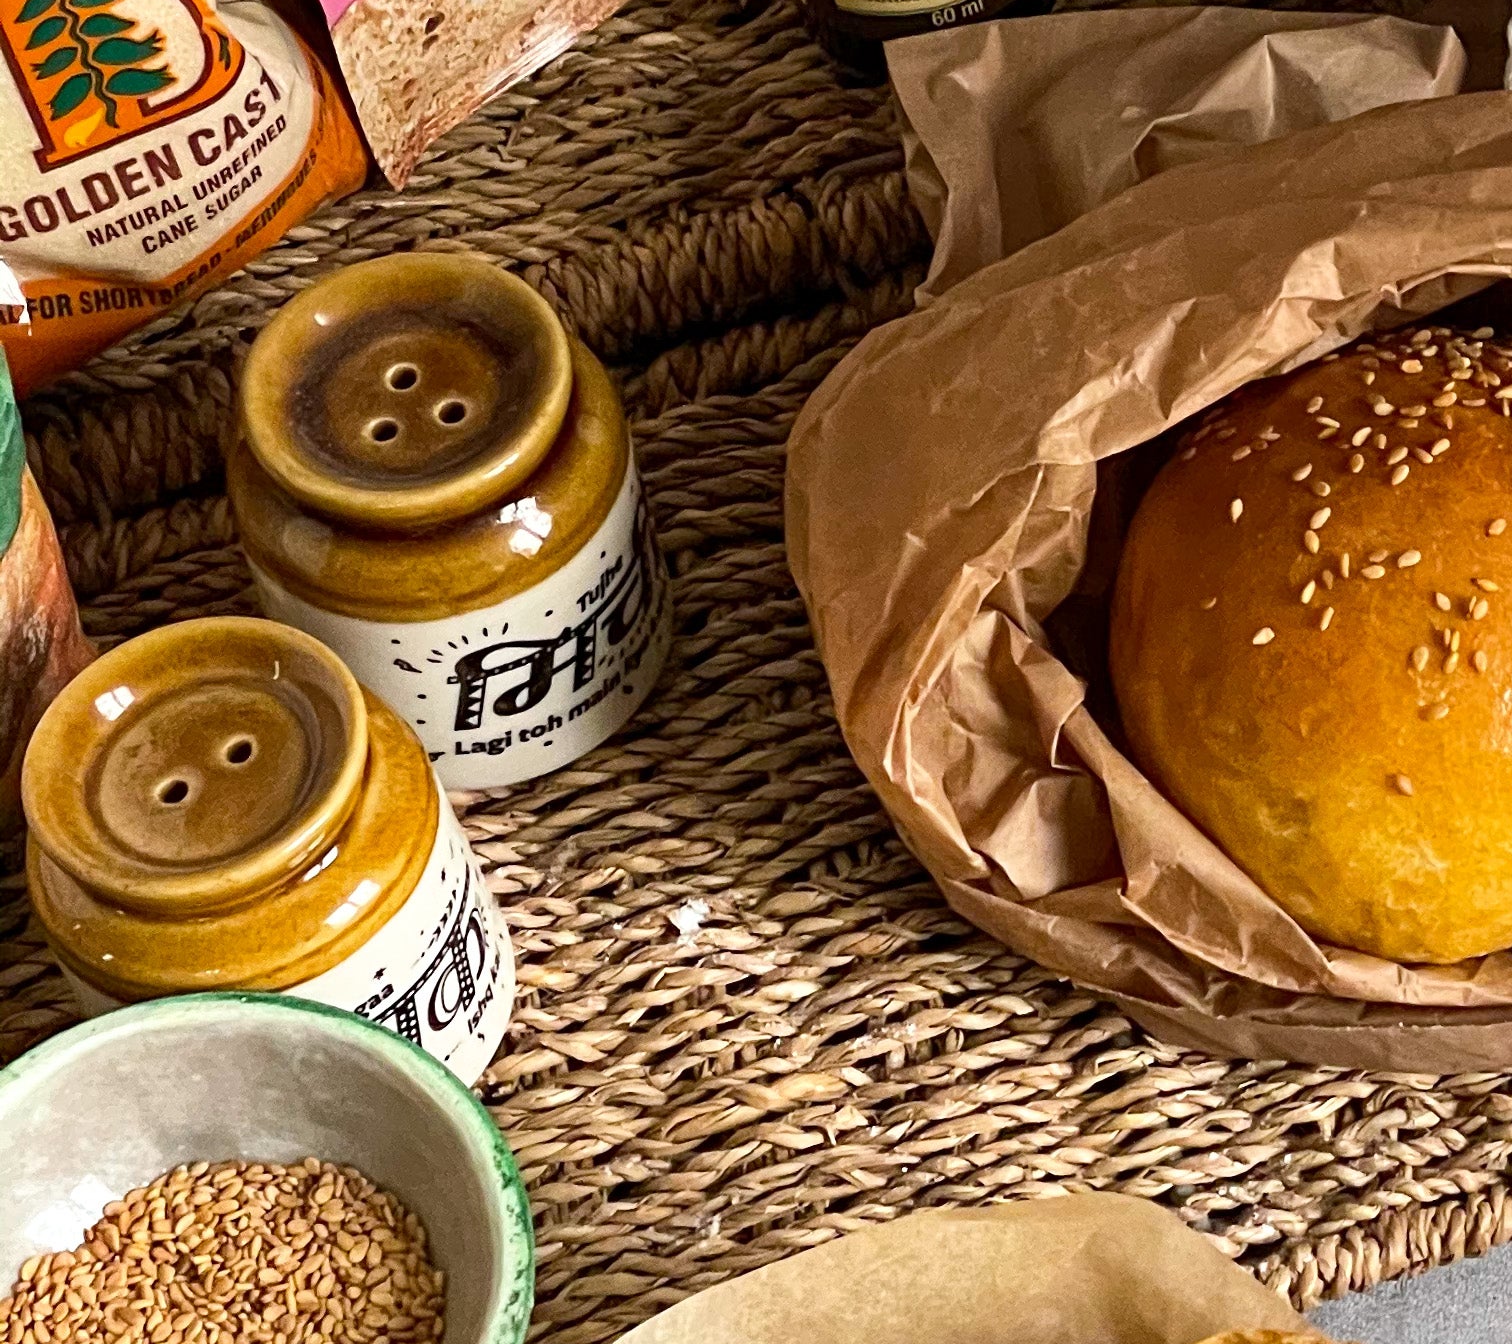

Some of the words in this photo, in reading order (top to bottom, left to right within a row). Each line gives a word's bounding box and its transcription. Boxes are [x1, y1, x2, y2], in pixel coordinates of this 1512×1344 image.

[931, 8, 956, 27] 60
[0, 143, 184, 243] GOLDEN
[186, 68, 282, 167] CAST
[86, 193, 189, 247] NATURAL
[192, 114, 287, 201] UNREFINED
[142, 214, 199, 255] CANE
[205, 164, 264, 220] SUGAR
[27, 295, 74, 321] FOR
[576, 554, 624, 614] Tujhe
[454, 730, 513, 756] Lagi
[518, 713, 563, 743] toh
[568, 671, 622, 722] main
